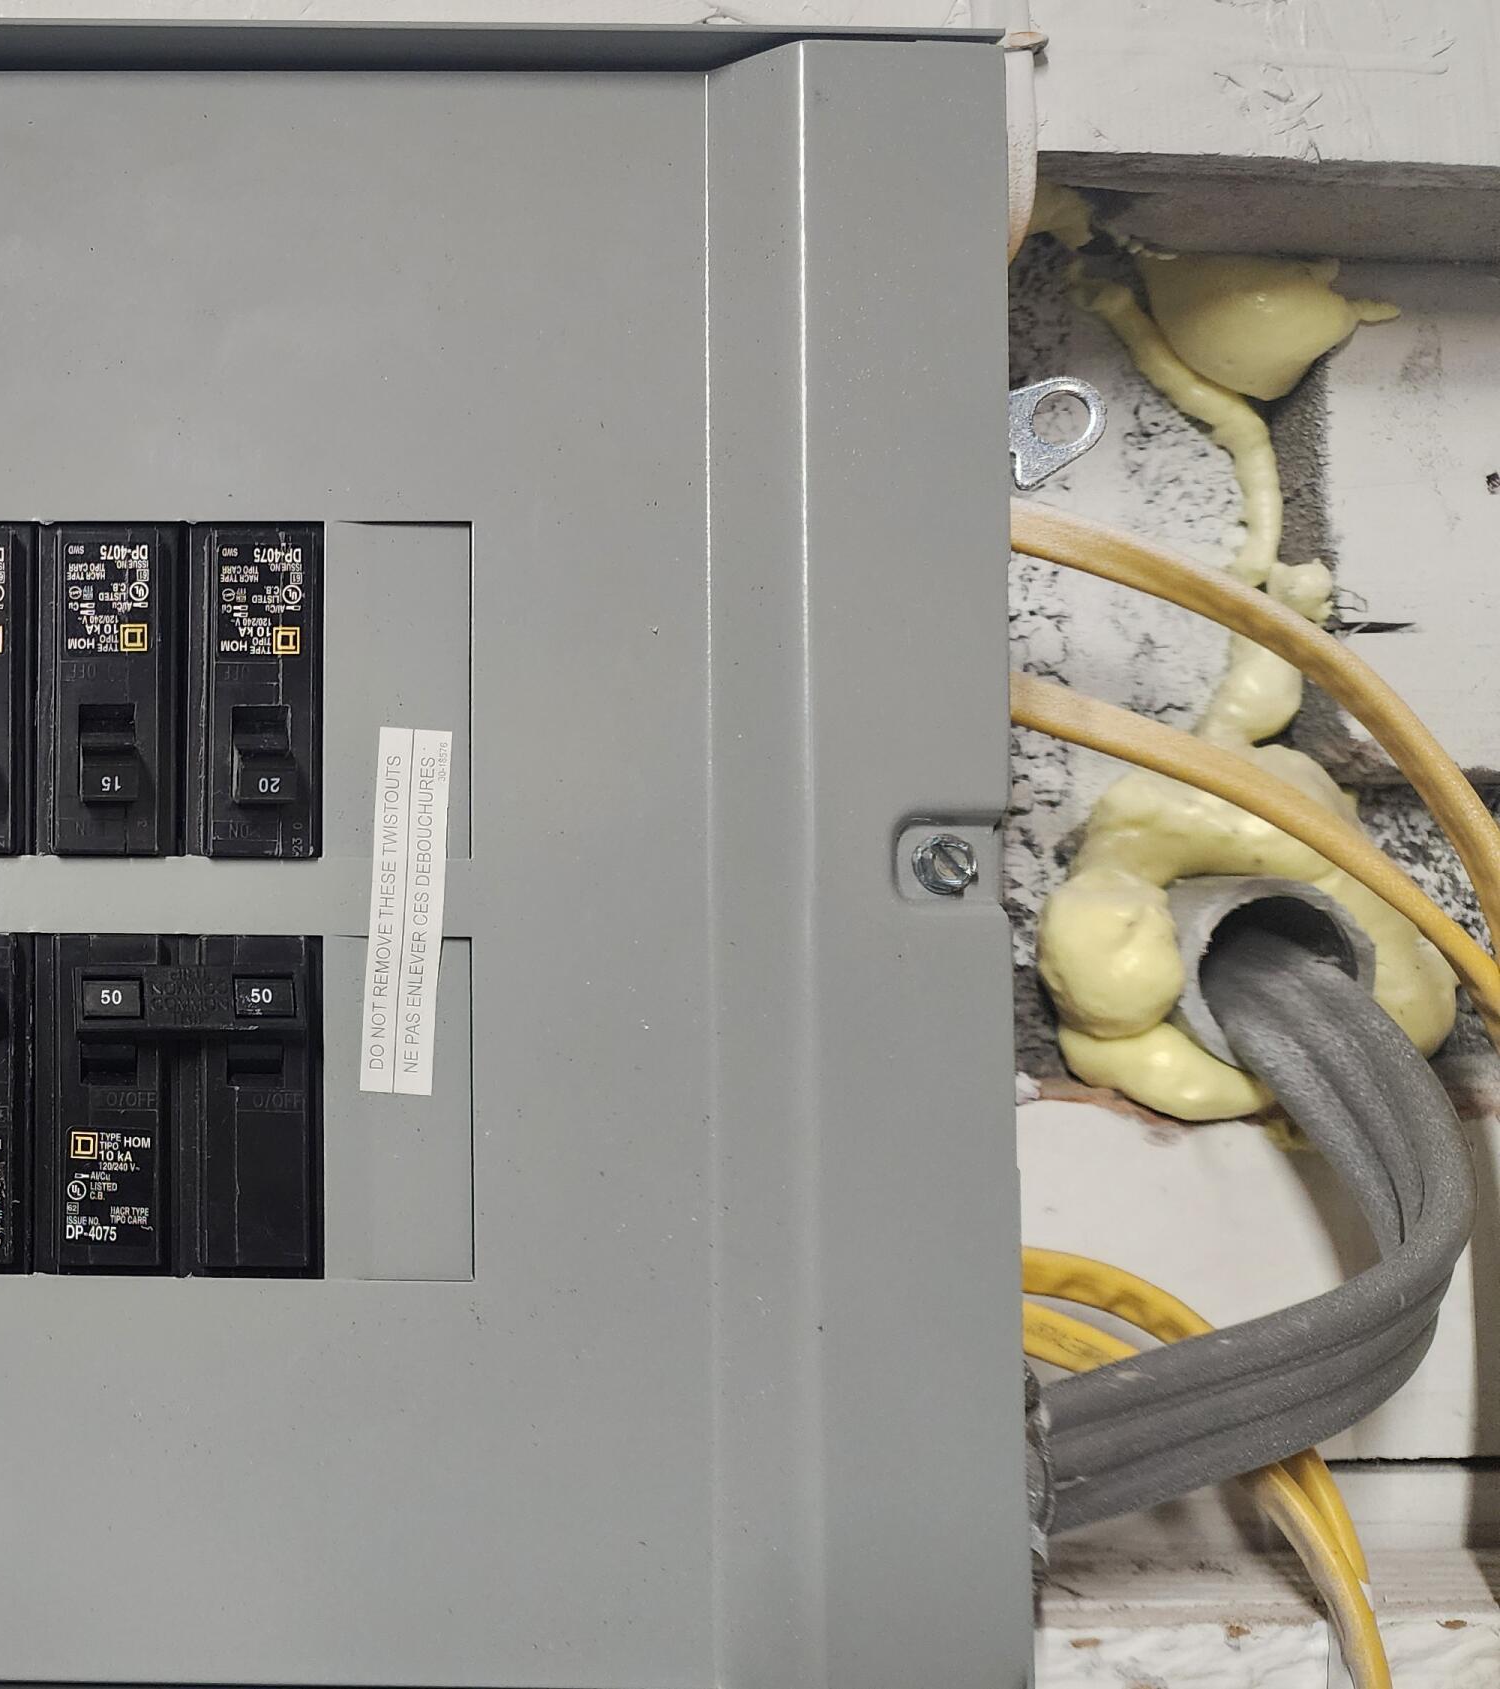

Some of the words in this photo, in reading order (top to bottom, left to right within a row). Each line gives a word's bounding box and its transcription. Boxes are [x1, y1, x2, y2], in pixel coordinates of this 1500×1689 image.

[68, 546, 84, 554] SWD
[100, 545, 148, 559] DP-4075
[222, 548, 238, 557] SWD
[254, 548, 301, 562] DP-4075
[69, 563, 88, 571] CARR
[90, 563, 105, 572] TIPO
[129, 560, 148, 569] ISSUE
[281, 563, 302, 571] ISSUE
[222, 566, 242, 574] CARR
[243, 566, 259, 574] TIPO
[67, 572, 84, 580] TYPE
[86, 572, 105, 580] HACR
[220, 574, 237, 582] TYPE
[239, 574, 258, 582] HACR
[110, 583, 126, 591] C.B.
[264, 586, 279, 594] C.B.
[99, 592, 126, 601] LISTED
[252, 595, 279, 603] LISTED
[90, 615, 118, 624] 120/240
[243, 618, 271, 626] 120/240
[85, 624, 100, 634] kA
[104, 624, 118, 634] 10
[238, 627, 253, 637] kA
[257, 627, 271, 636] 10
[68, 638, 95, 649] HOM
[99, 635, 118, 643] TIPO
[252, 637, 271, 645] TIPO
[97, 643, 118, 652] TYPE
[221, 640, 247, 651] HOM
[250, 646, 271, 654] TYPE
[70, 663, 97, 679] OFF
[101, 776, 121, 791] 15
[258, 777, 280, 793] 20
[382, 756, 401, 855] TWISTOUTS
[415, 757, 435, 886] DEBOUCHURES
[379, 861, 396, 918] THESE
[413, 892, 429, 925] CES
[373, 924, 392, 997] REMOVE
[406, 931, 427, 1007] ENLEVER
[100, 989, 123, 1005] 50
[251, 988, 273, 1004] 50
[371, 1002, 386, 1038] NOT
[405, 1013, 420, 1044] PAS
[369, 1045, 384, 1070] DO
[403, 1050, 418, 1073] NE
[100, 1133, 121, 1141] TYPE
[100, 1142, 119, 1150] TIPO
[124, 1137, 150, 1148] HOM
[99, 1151, 114, 1161] 10
[118, 1151, 132, 1161] kA
[99, 1162, 127, 1171] 120/240
[90, 1182, 117, 1191] LISTED
[90, 1192, 105, 1200] C.B.
[111, 1206, 130, 1215] HACR
[131, 1207, 149, 1216] TYPE
[66, 1216, 87, 1225] ISSUE
[110, 1215, 126, 1224] TIPO
[128, 1216, 147, 1224] CARR
[66, 1225, 116, 1241] DP-4075
